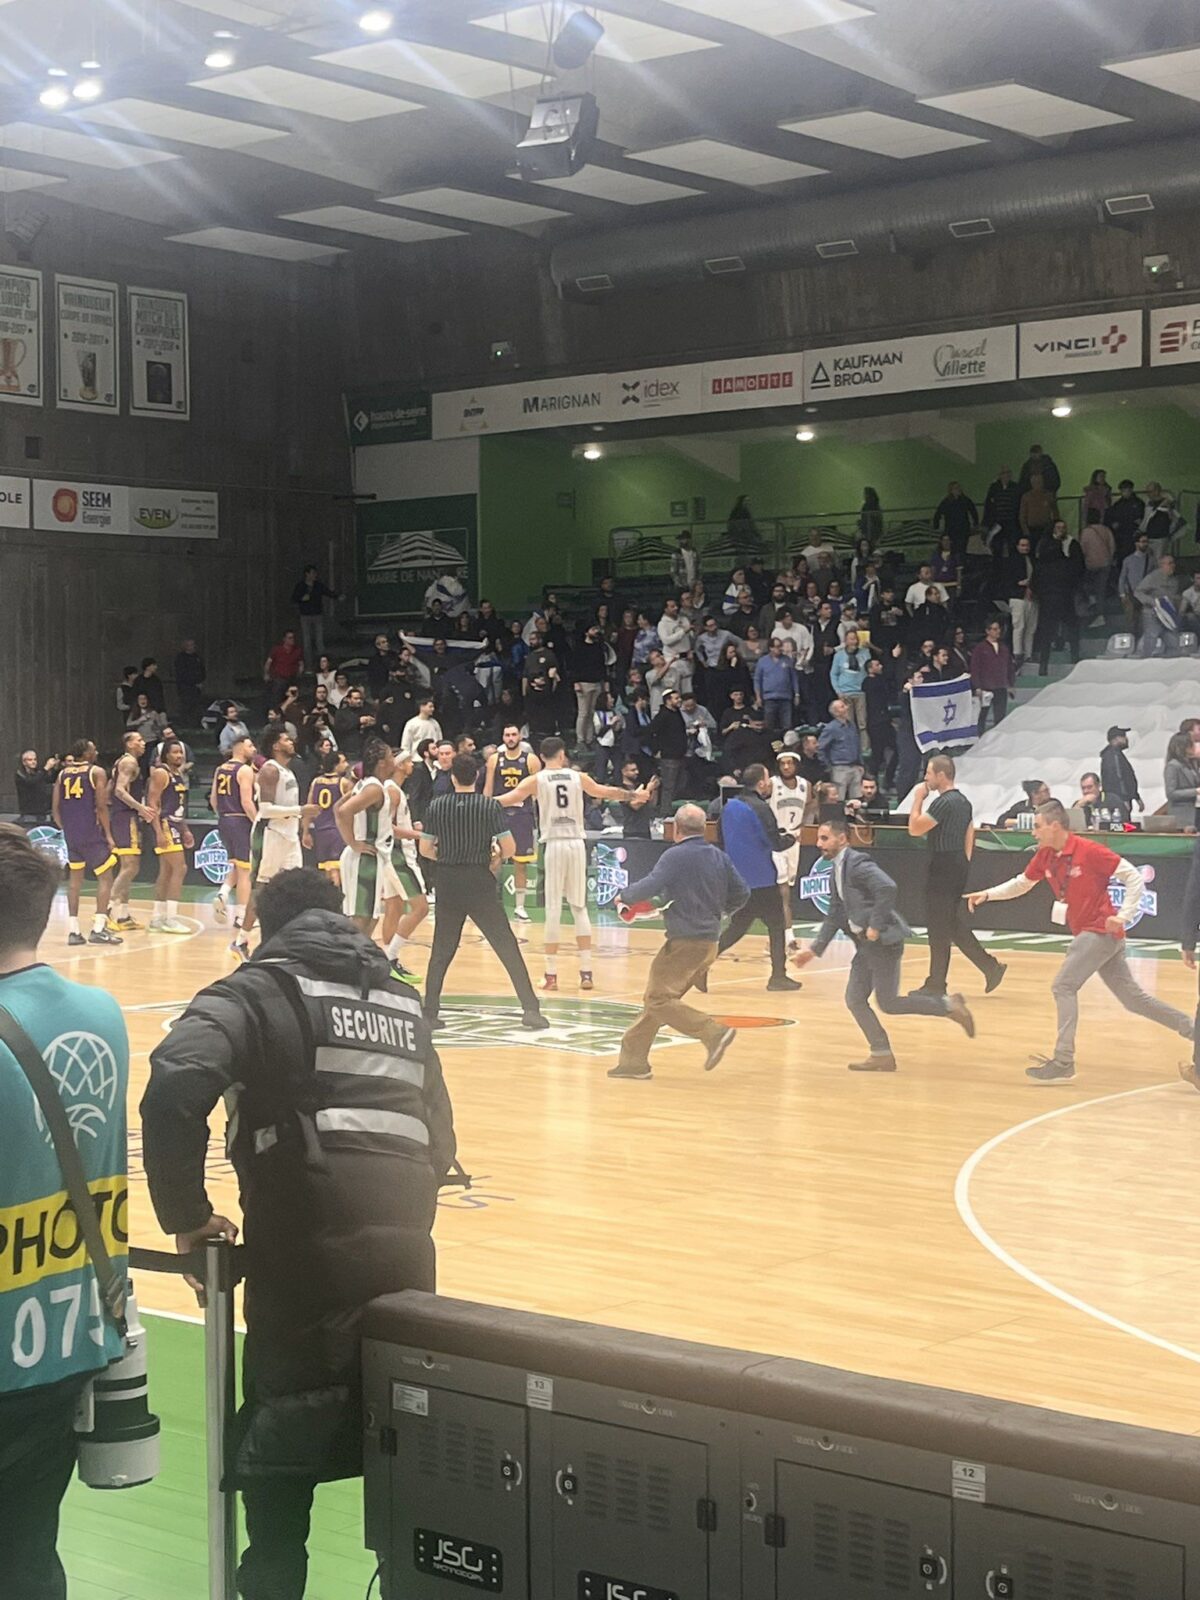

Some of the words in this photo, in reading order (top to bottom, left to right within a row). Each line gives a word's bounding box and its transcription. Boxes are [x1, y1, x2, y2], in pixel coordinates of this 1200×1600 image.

[1034, 337, 1096, 352] VINCI
[833, 351, 903, 371] KAUFMAN
[643, 379, 680, 398] idex
[713, 372, 792, 394] LAMOTTE
[834, 370, 884, 388] BROAD
[523, 391, 601, 413] MARIGNAN
[82, 490, 111, 508] SEEM
[139, 507, 171, 520] EVEN
[63, 776, 84, 800] 14
[217, 773, 232, 796] 21
[504, 776, 519, 788] 20
[318, 788, 332, 809] 0
[556, 784, 569, 808] 6
[789, 811, 796, 823] 7
[331, 1005, 417, 1051] SECURITE
[534, 1380, 545, 1390] 13
[962, 1468, 976, 1478] 12
